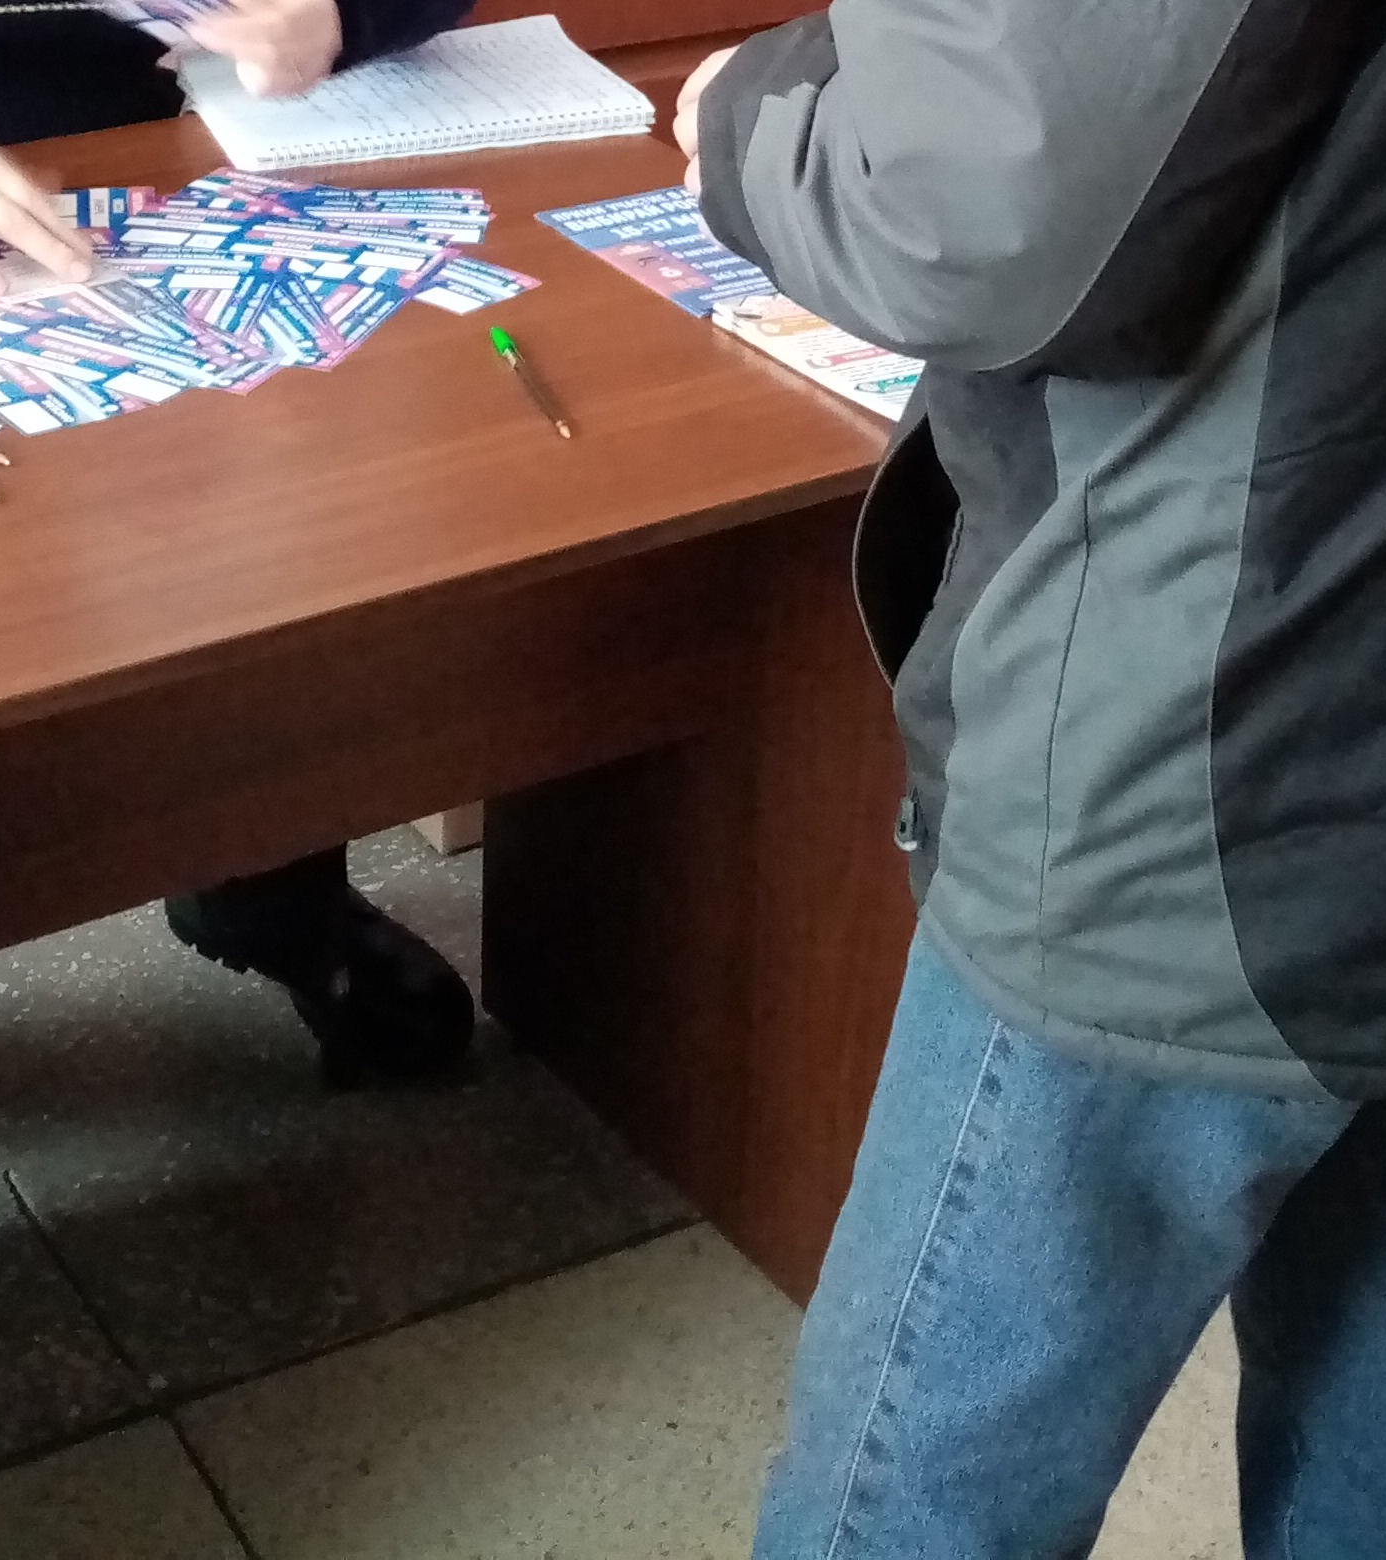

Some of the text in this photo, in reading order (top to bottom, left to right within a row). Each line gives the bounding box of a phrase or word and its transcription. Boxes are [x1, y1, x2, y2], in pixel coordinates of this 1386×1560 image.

[550, 205, 607, 222] ПРИМИ
[605, 193, 666, 211] УЧАСТИЕ
[563, 203, 663, 231] ВЫБИРАЙ
[610, 218, 673, 239] 15-17
